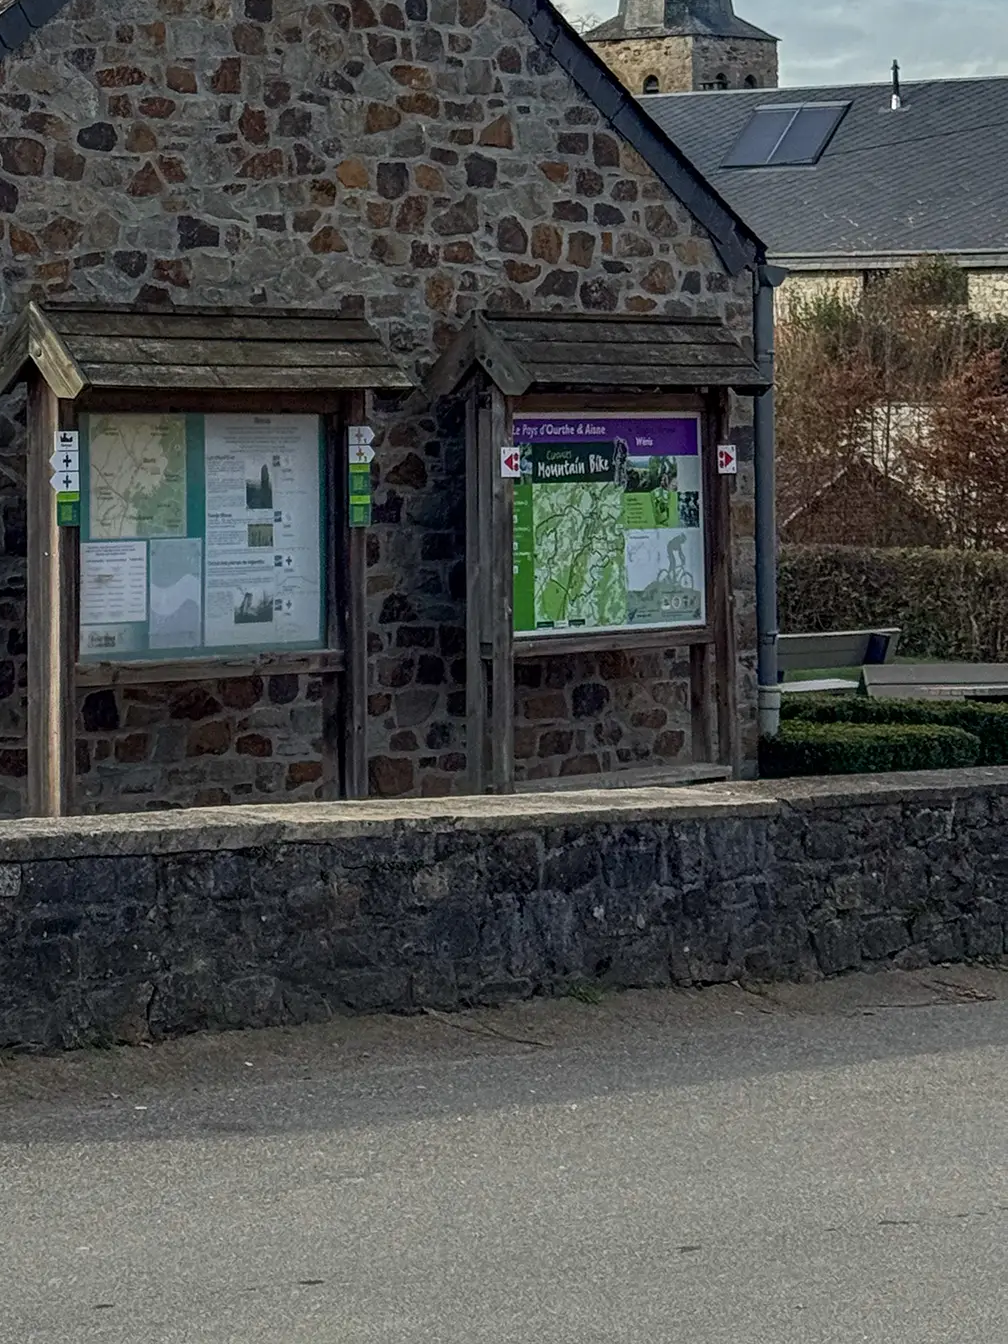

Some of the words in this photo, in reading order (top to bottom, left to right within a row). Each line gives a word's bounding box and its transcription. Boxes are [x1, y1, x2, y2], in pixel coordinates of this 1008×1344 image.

[512, 424, 520, 435] Le
[522, 424, 538, 439] Pays
[539, 423, 575, 435] d'Ourthe
[576, 423, 584, 435] &
[585, 423, 606, 435] Aisne
[537, 456, 585, 479] Mountain
[588, 454, 610, 474] Bike
